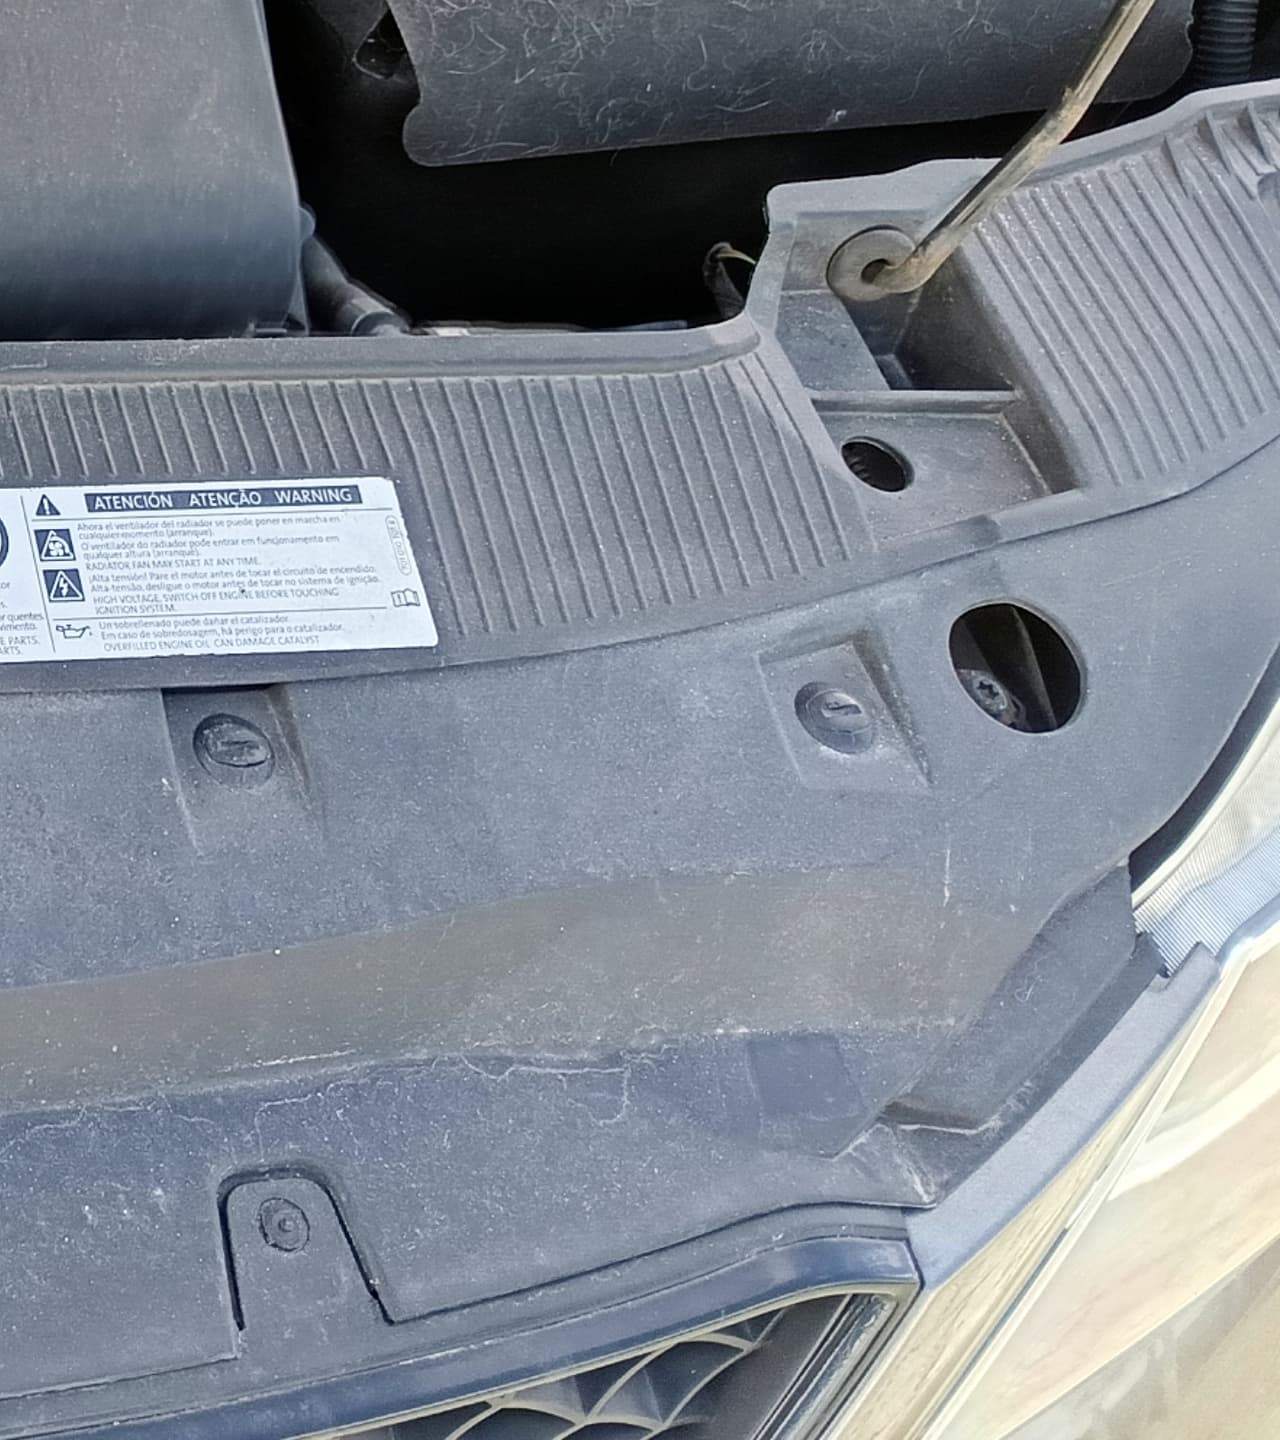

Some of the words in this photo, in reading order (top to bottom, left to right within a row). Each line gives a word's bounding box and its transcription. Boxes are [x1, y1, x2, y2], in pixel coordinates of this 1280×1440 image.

[94, 491, 174, 511] ATENCIÓN
[189, 488, 262, 508] ATENÇÃO
[274, 487, 353, 504] WARNING
